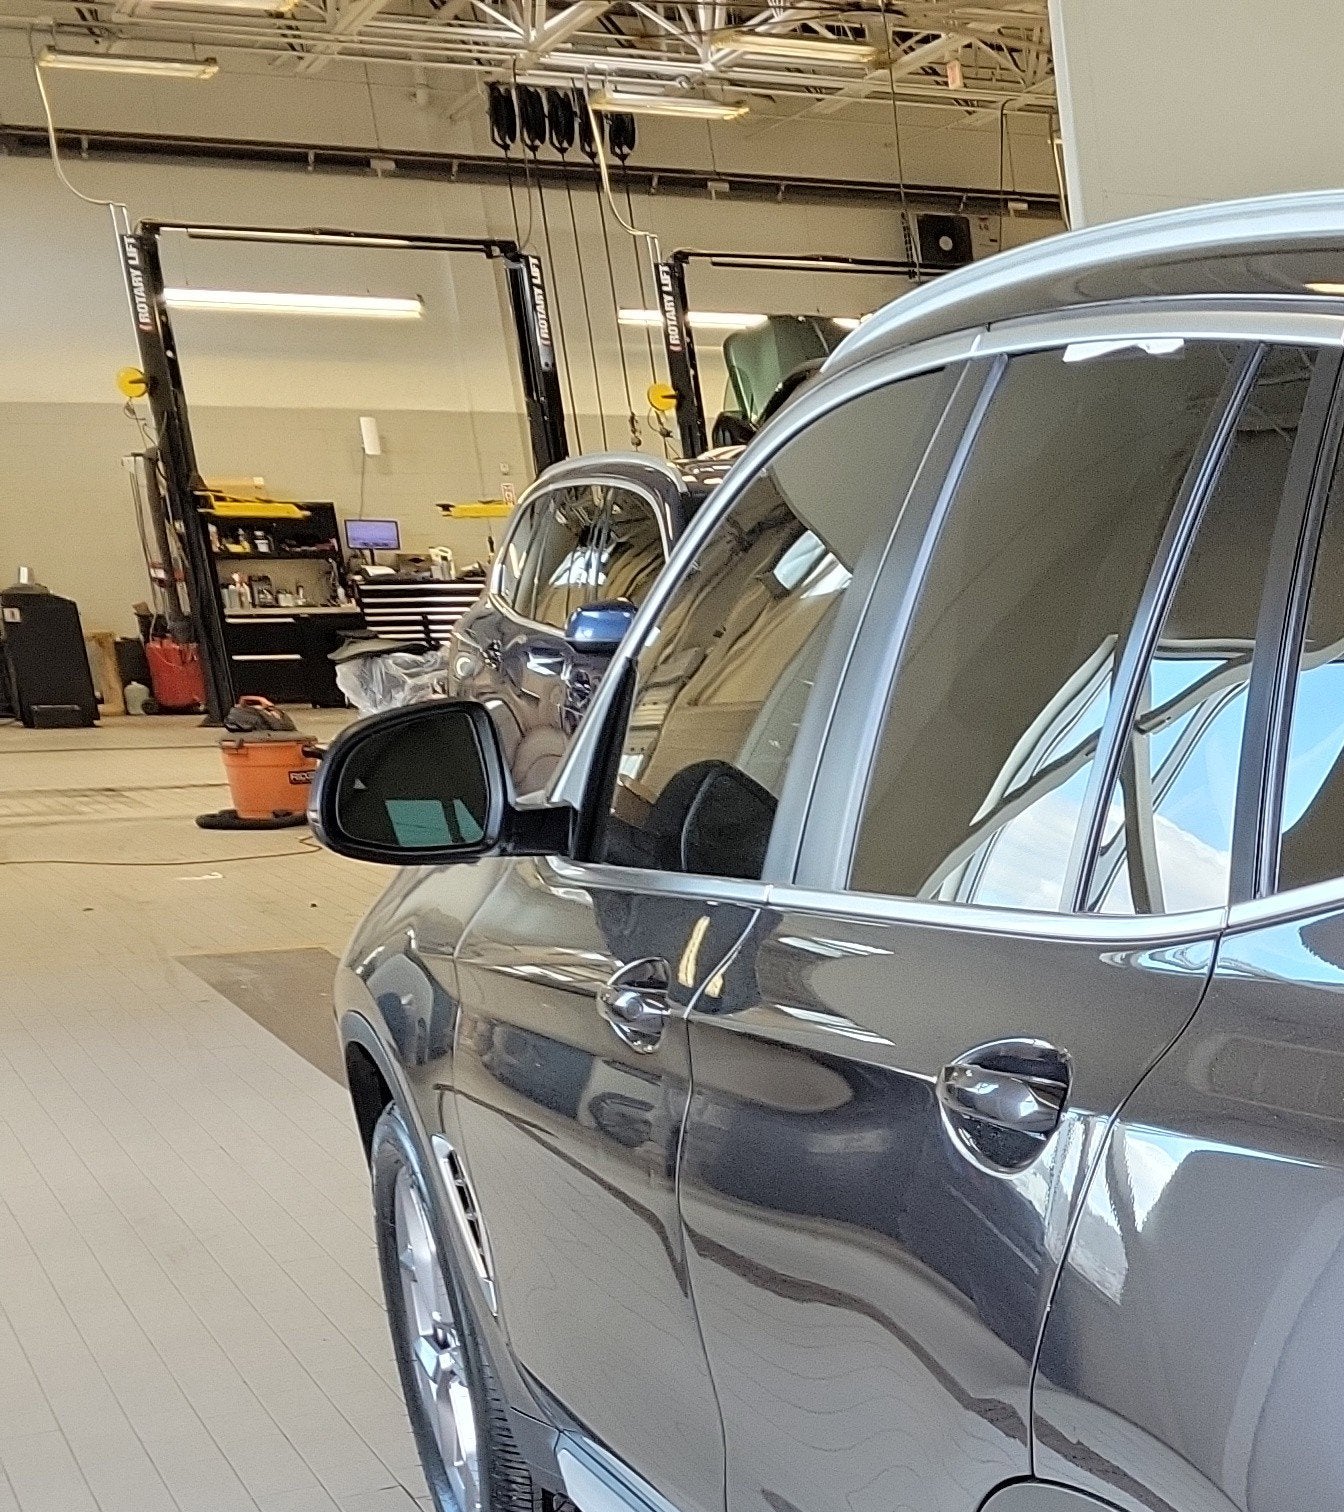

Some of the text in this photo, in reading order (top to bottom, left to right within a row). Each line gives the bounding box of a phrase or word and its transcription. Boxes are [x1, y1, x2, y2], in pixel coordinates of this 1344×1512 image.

[123, 235, 152, 323] ROTARY LIFT
[528, 256, 550, 339] ROTARY LIFT
[658, 264, 681, 344] ROTARY LIFT
